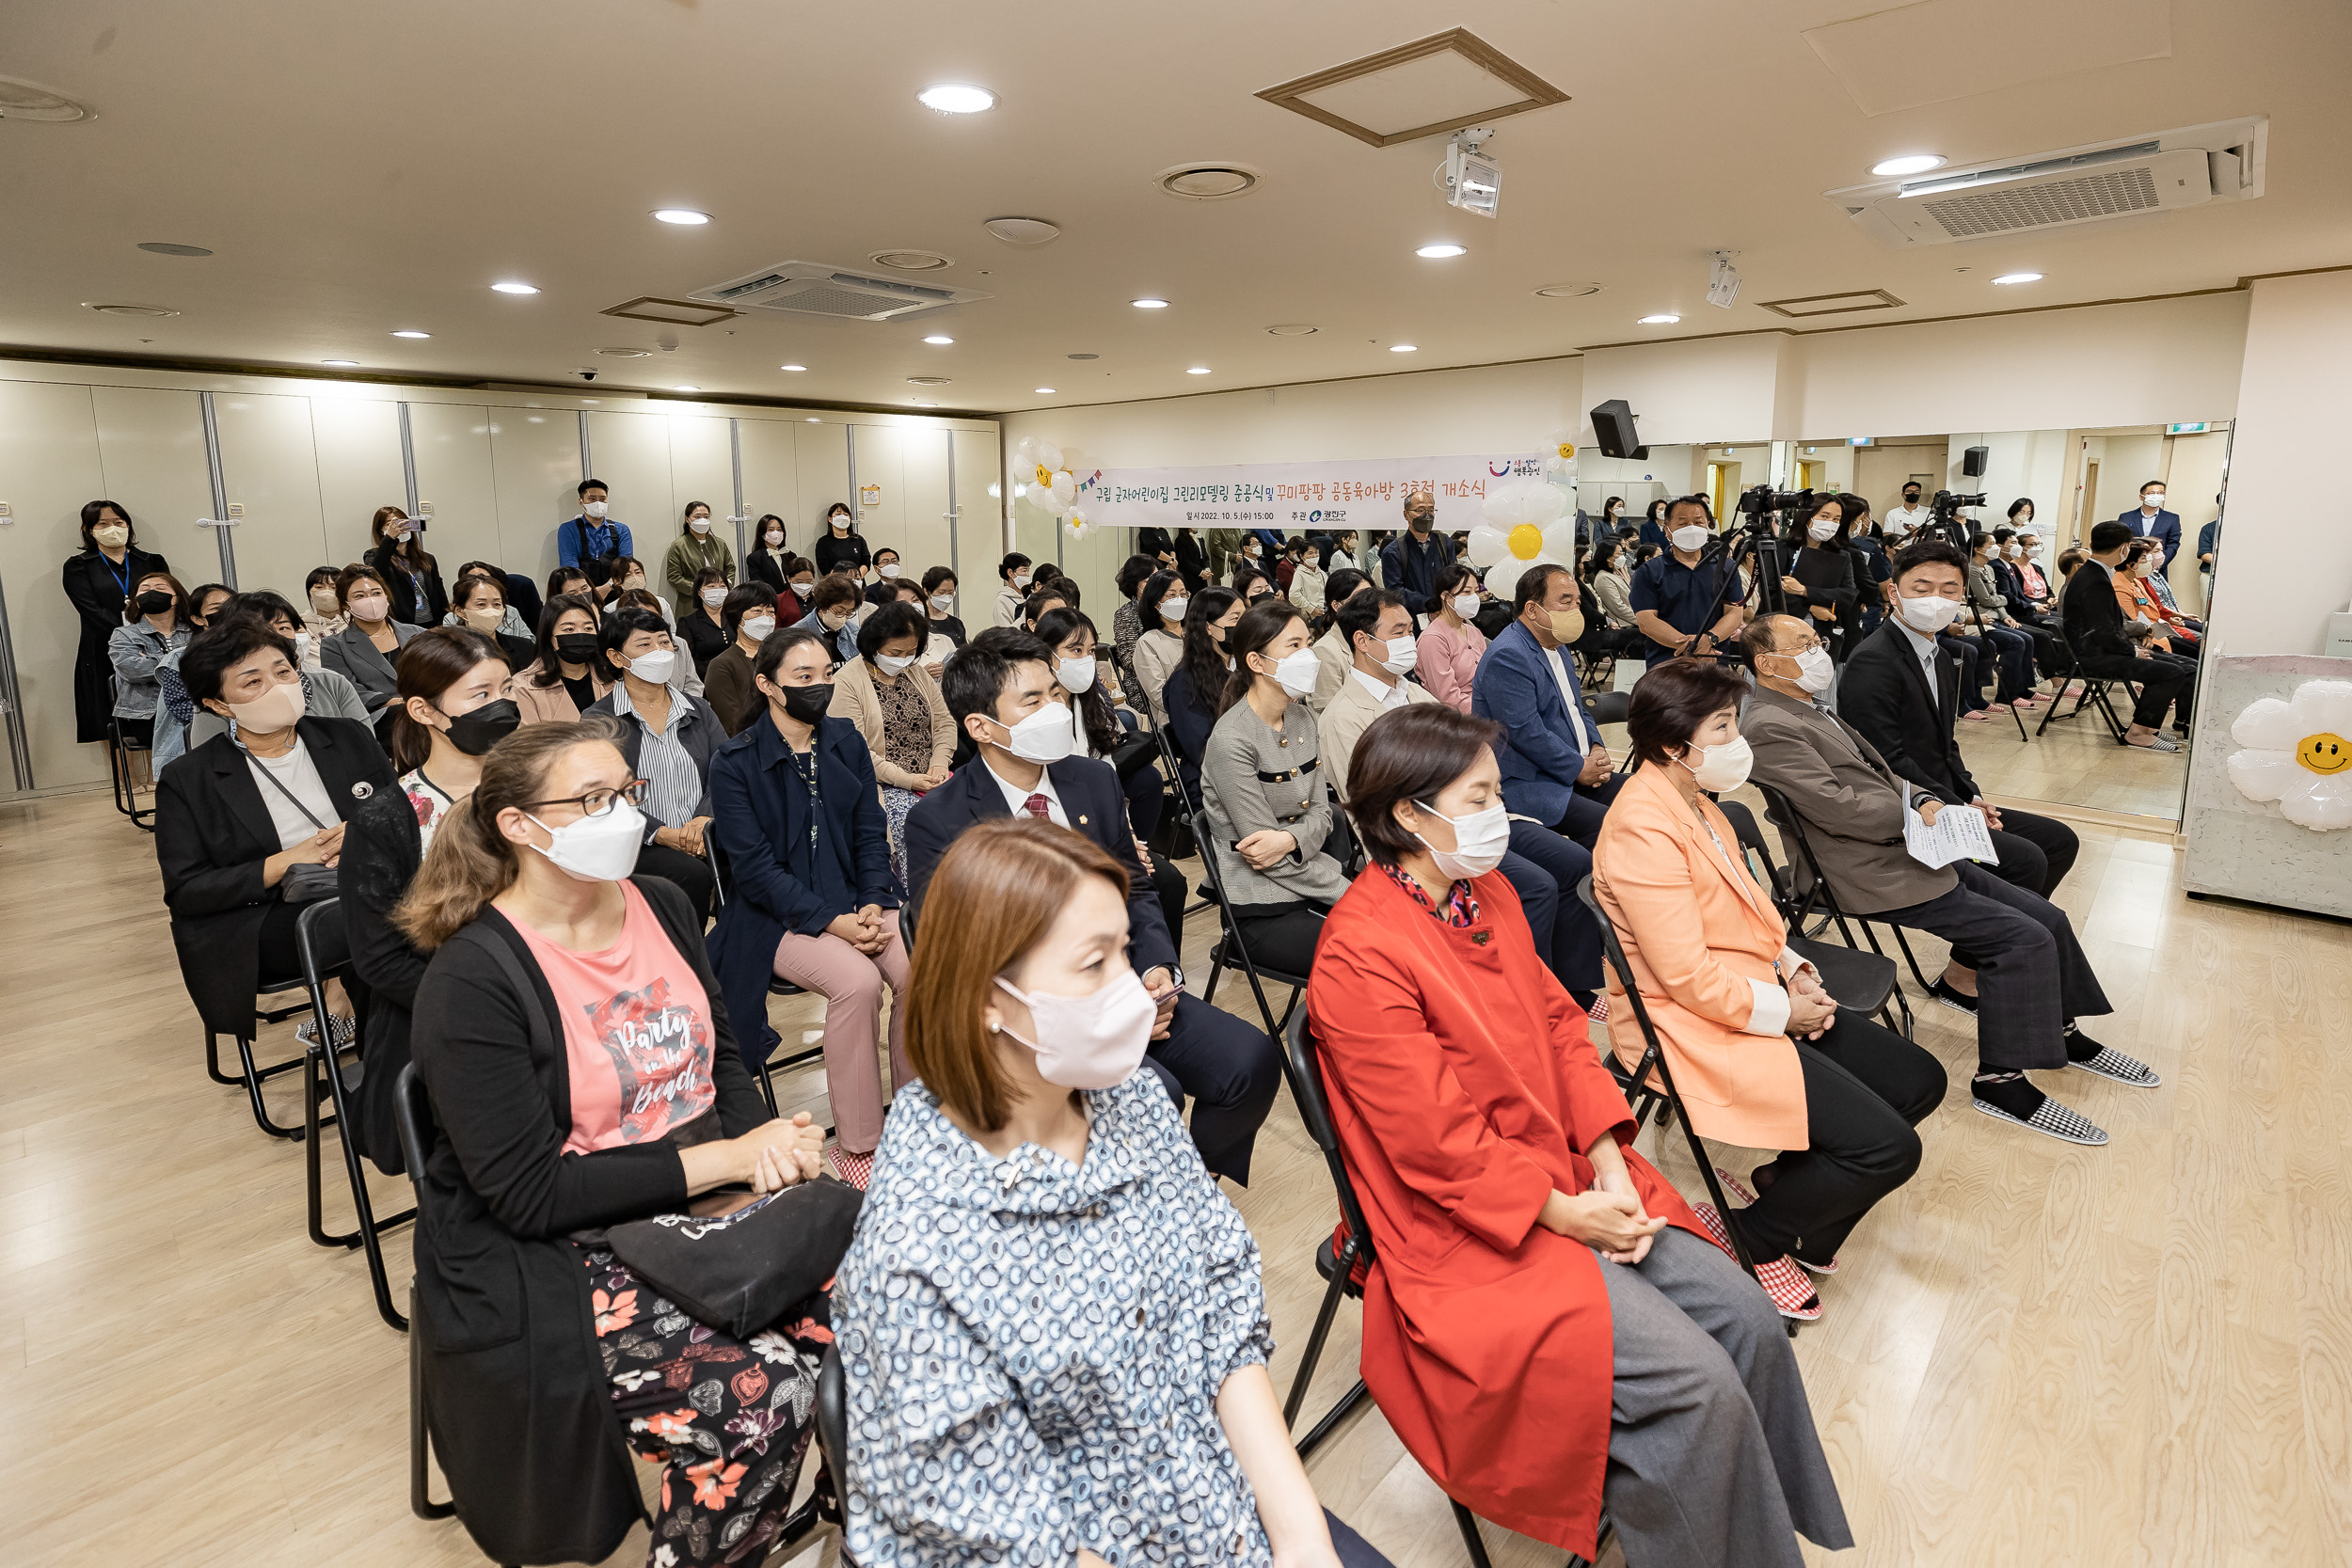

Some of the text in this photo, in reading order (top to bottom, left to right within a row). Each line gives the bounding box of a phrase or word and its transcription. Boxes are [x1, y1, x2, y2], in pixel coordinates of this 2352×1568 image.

[1096, 486, 1111, 502] 구립
[1115, 485, 1168, 503] 군자어린이집
[1172, 483, 1230, 503] 그린리모델링
[1277, 483, 1326, 502] 꾸미팡팡
[1331, 481, 1394, 501] 공동육아방
[1441, 479, 1486, 500] 개소식
[1200, 512, 1219, 520] 2022.
[1221, 512, 1232, 520] 10.
[1253, 512, 1275, 520] 15:00
[1323, 510, 1346, 518] 광진구
[616, 1006, 694, 1056] Party
[644, 1047, 686, 1075] on the
[631, 1056, 699, 1115] Beach
